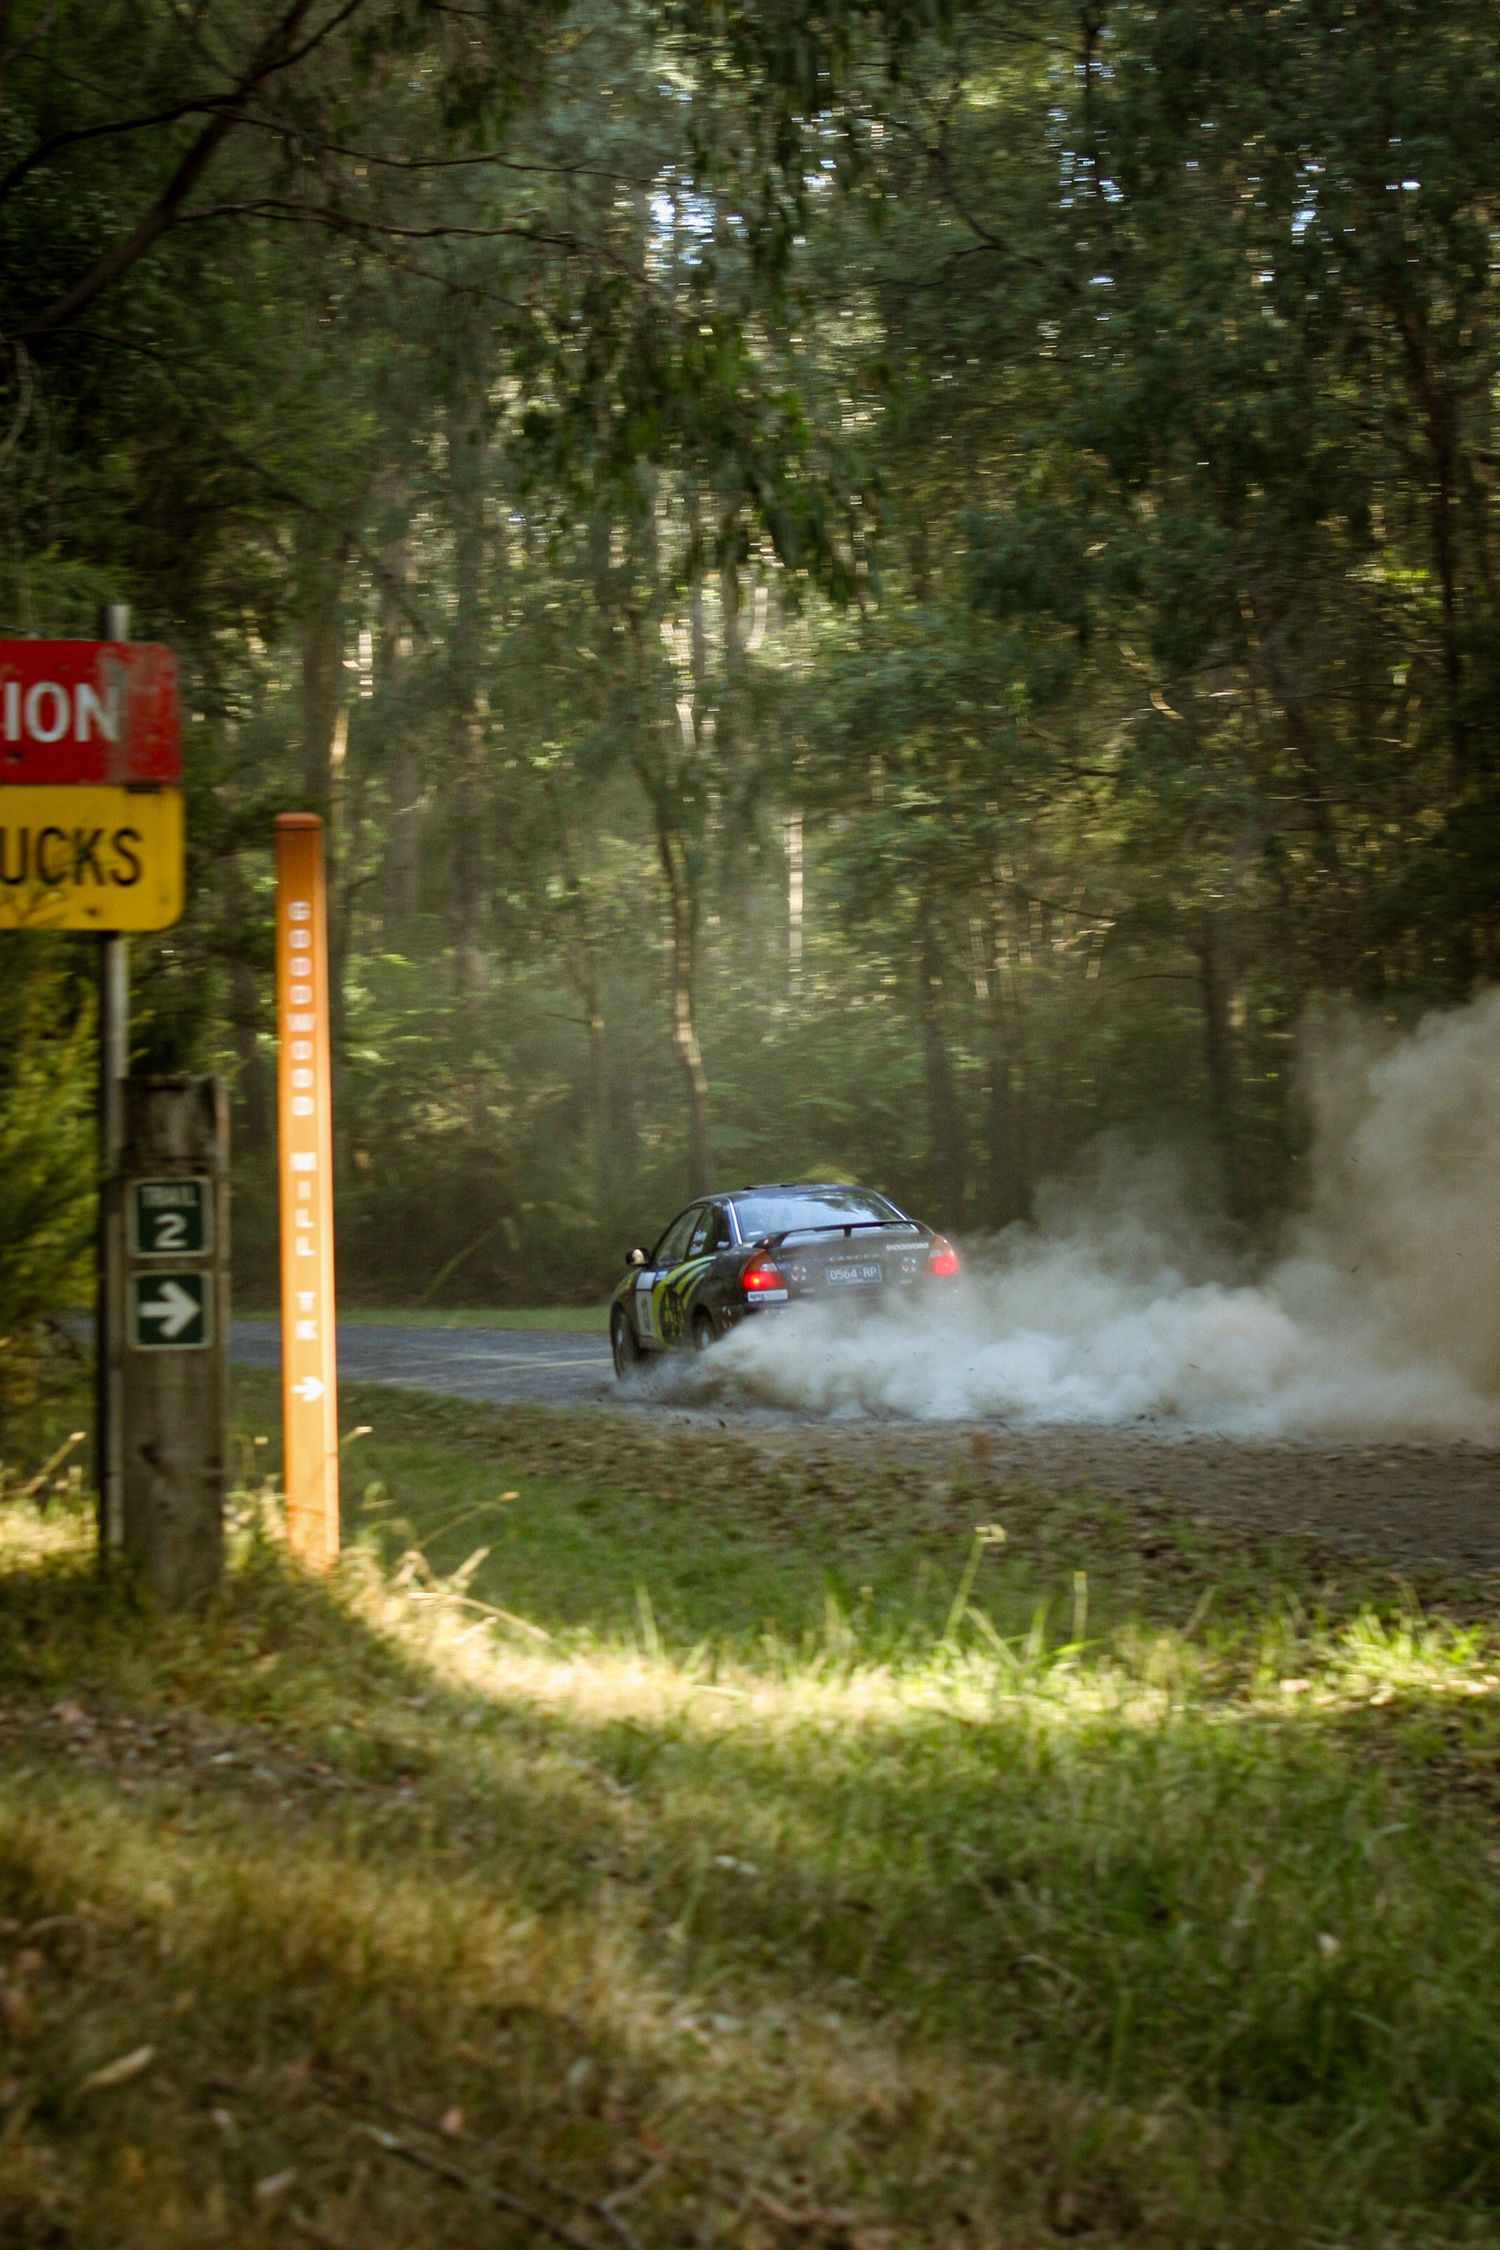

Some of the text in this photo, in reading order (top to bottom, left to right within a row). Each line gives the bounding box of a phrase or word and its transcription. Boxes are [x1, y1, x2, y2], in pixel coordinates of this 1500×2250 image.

[4, 681, 120, 743] ION
[0, 826, 143, 887] UCKS
[153, 1212, 188, 1250] 2
[295, 1291, 319, 1341] TK
